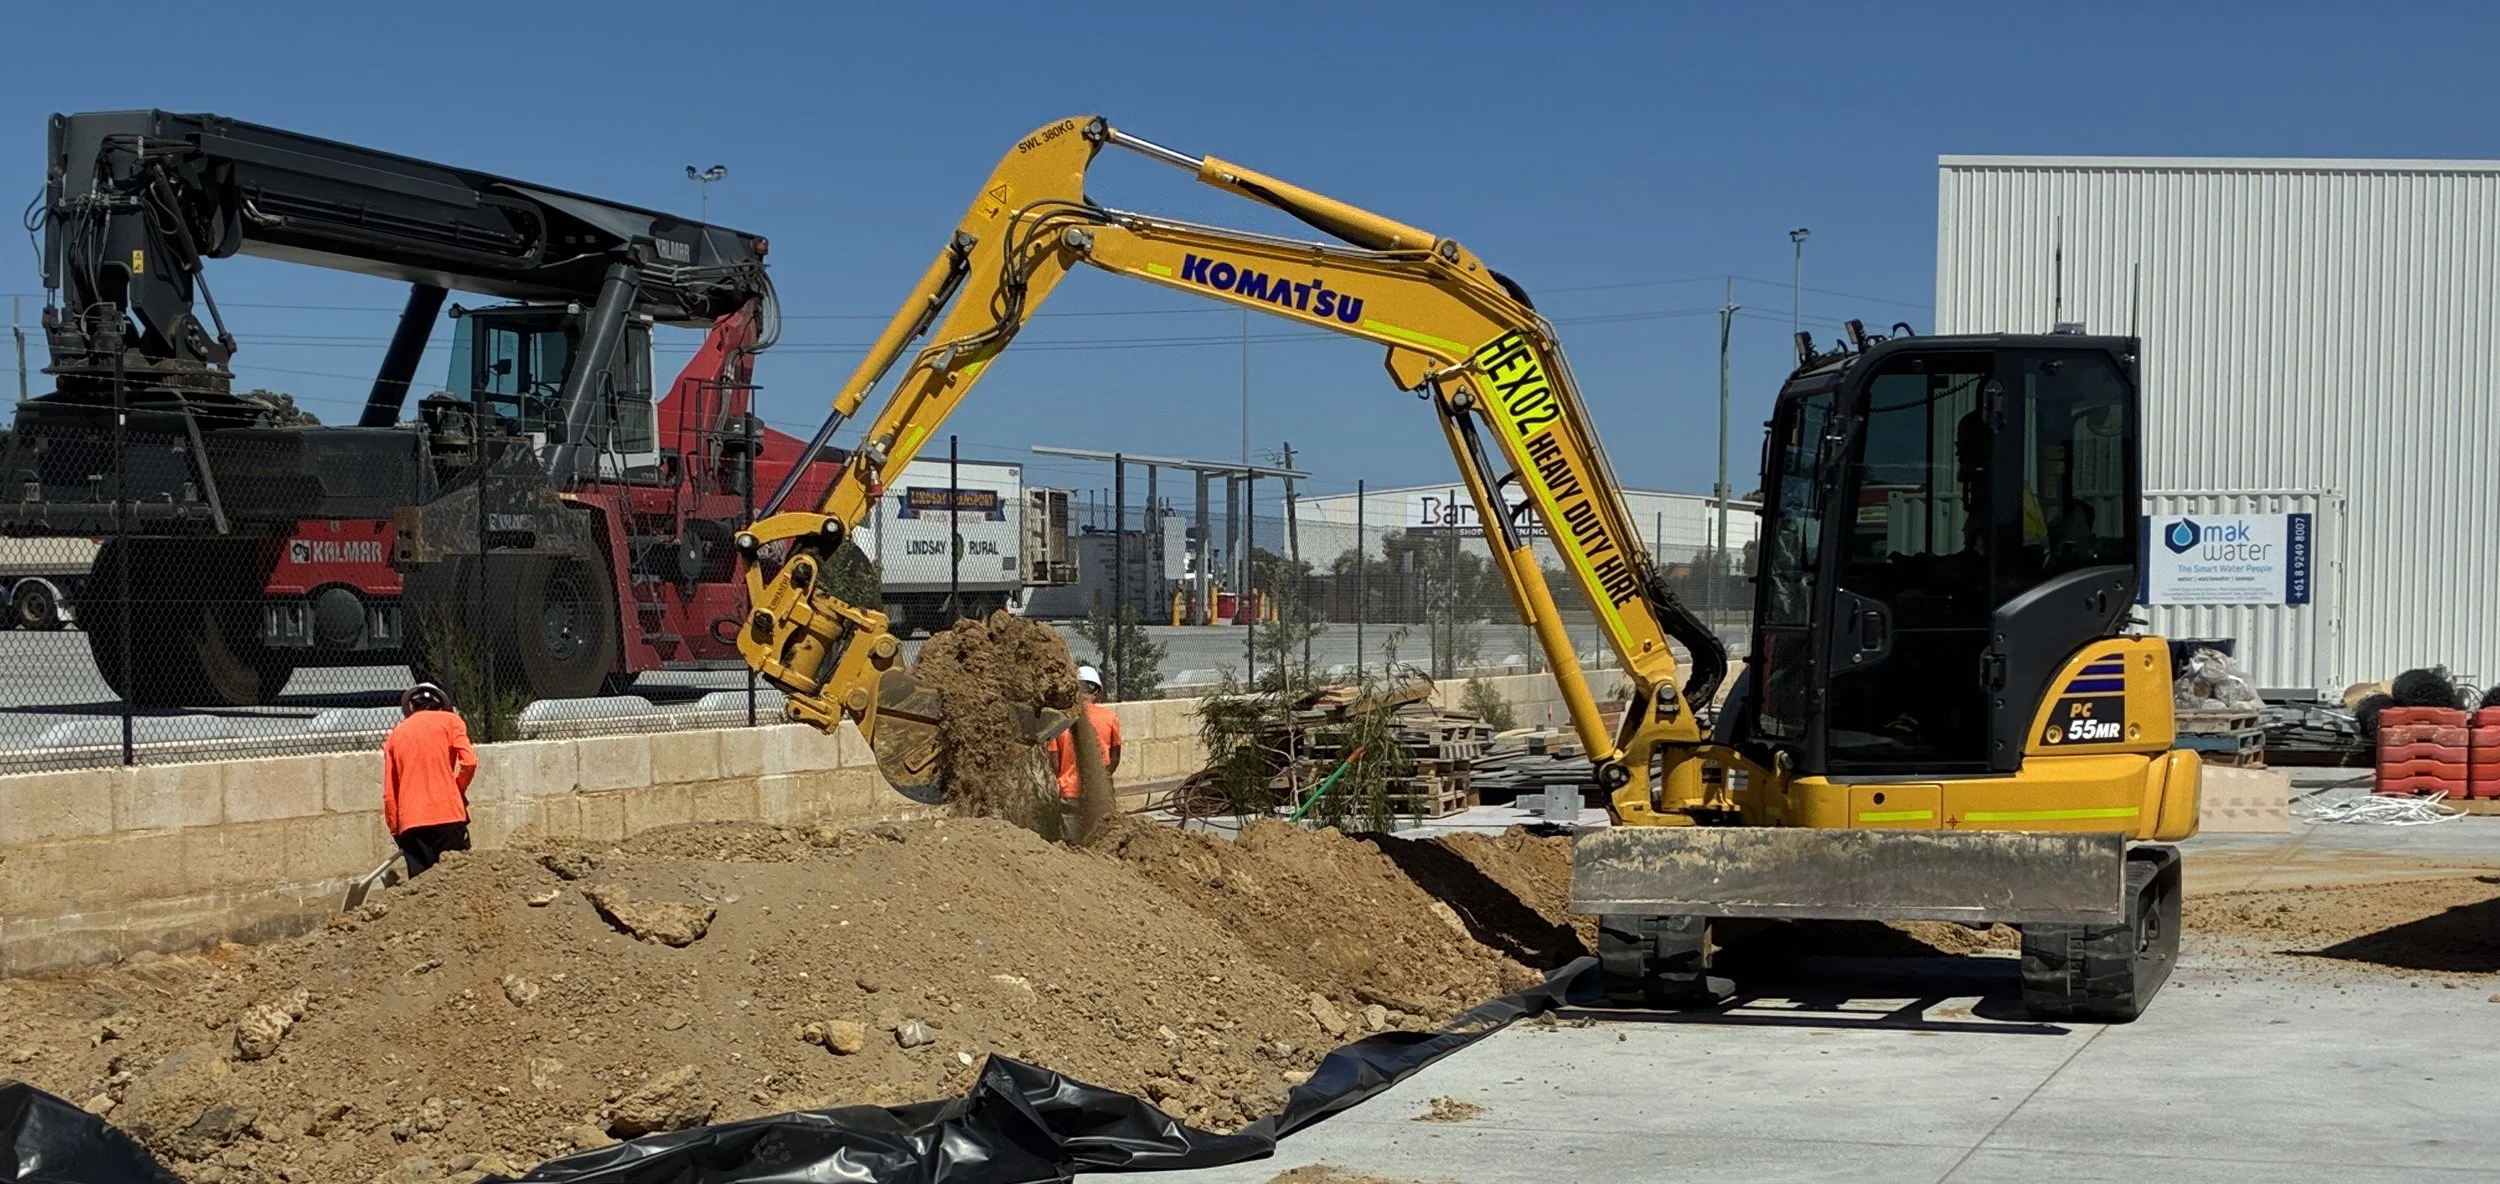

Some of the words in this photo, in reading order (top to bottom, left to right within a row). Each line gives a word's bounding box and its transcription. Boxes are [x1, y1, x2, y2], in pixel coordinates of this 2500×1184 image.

[1018, 137, 1043, 154] SWL
[1042, 120, 1075, 142] 380KG
[1181, 253, 1364, 324] KOMATSU
[1475, 328, 1560, 436] HEX02
[1526, 431, 1584, 503] HEAVY
[1563, 499, 1614, 559] DUTY
[1594, 555, 1641, 610] HIRE
[2204, 520, 2250, 542] mak
[2295, 517, 2306, 542] 8007
[313, 541, 382, 562] KALMAR
[906, 541, 947, 555] LINDSAY
[968, 541, 1000, 555] RURAL
[2203, 544, 2272, 561] water
[2294, 544, 2305, 569] 9249
[2178, 565, 2193, 573] The
[2194, 565, 2219, 573] Smart
[2219, 565, 2245, 573] Water
[2246, 565, 2273, 574] People
[2294, 570, 2305, 578] 8
[2294, 578, 2305, 598] +61
[2070, 703, 2093, 718] PC
[2068, 719, 2120, 739] 55MR
